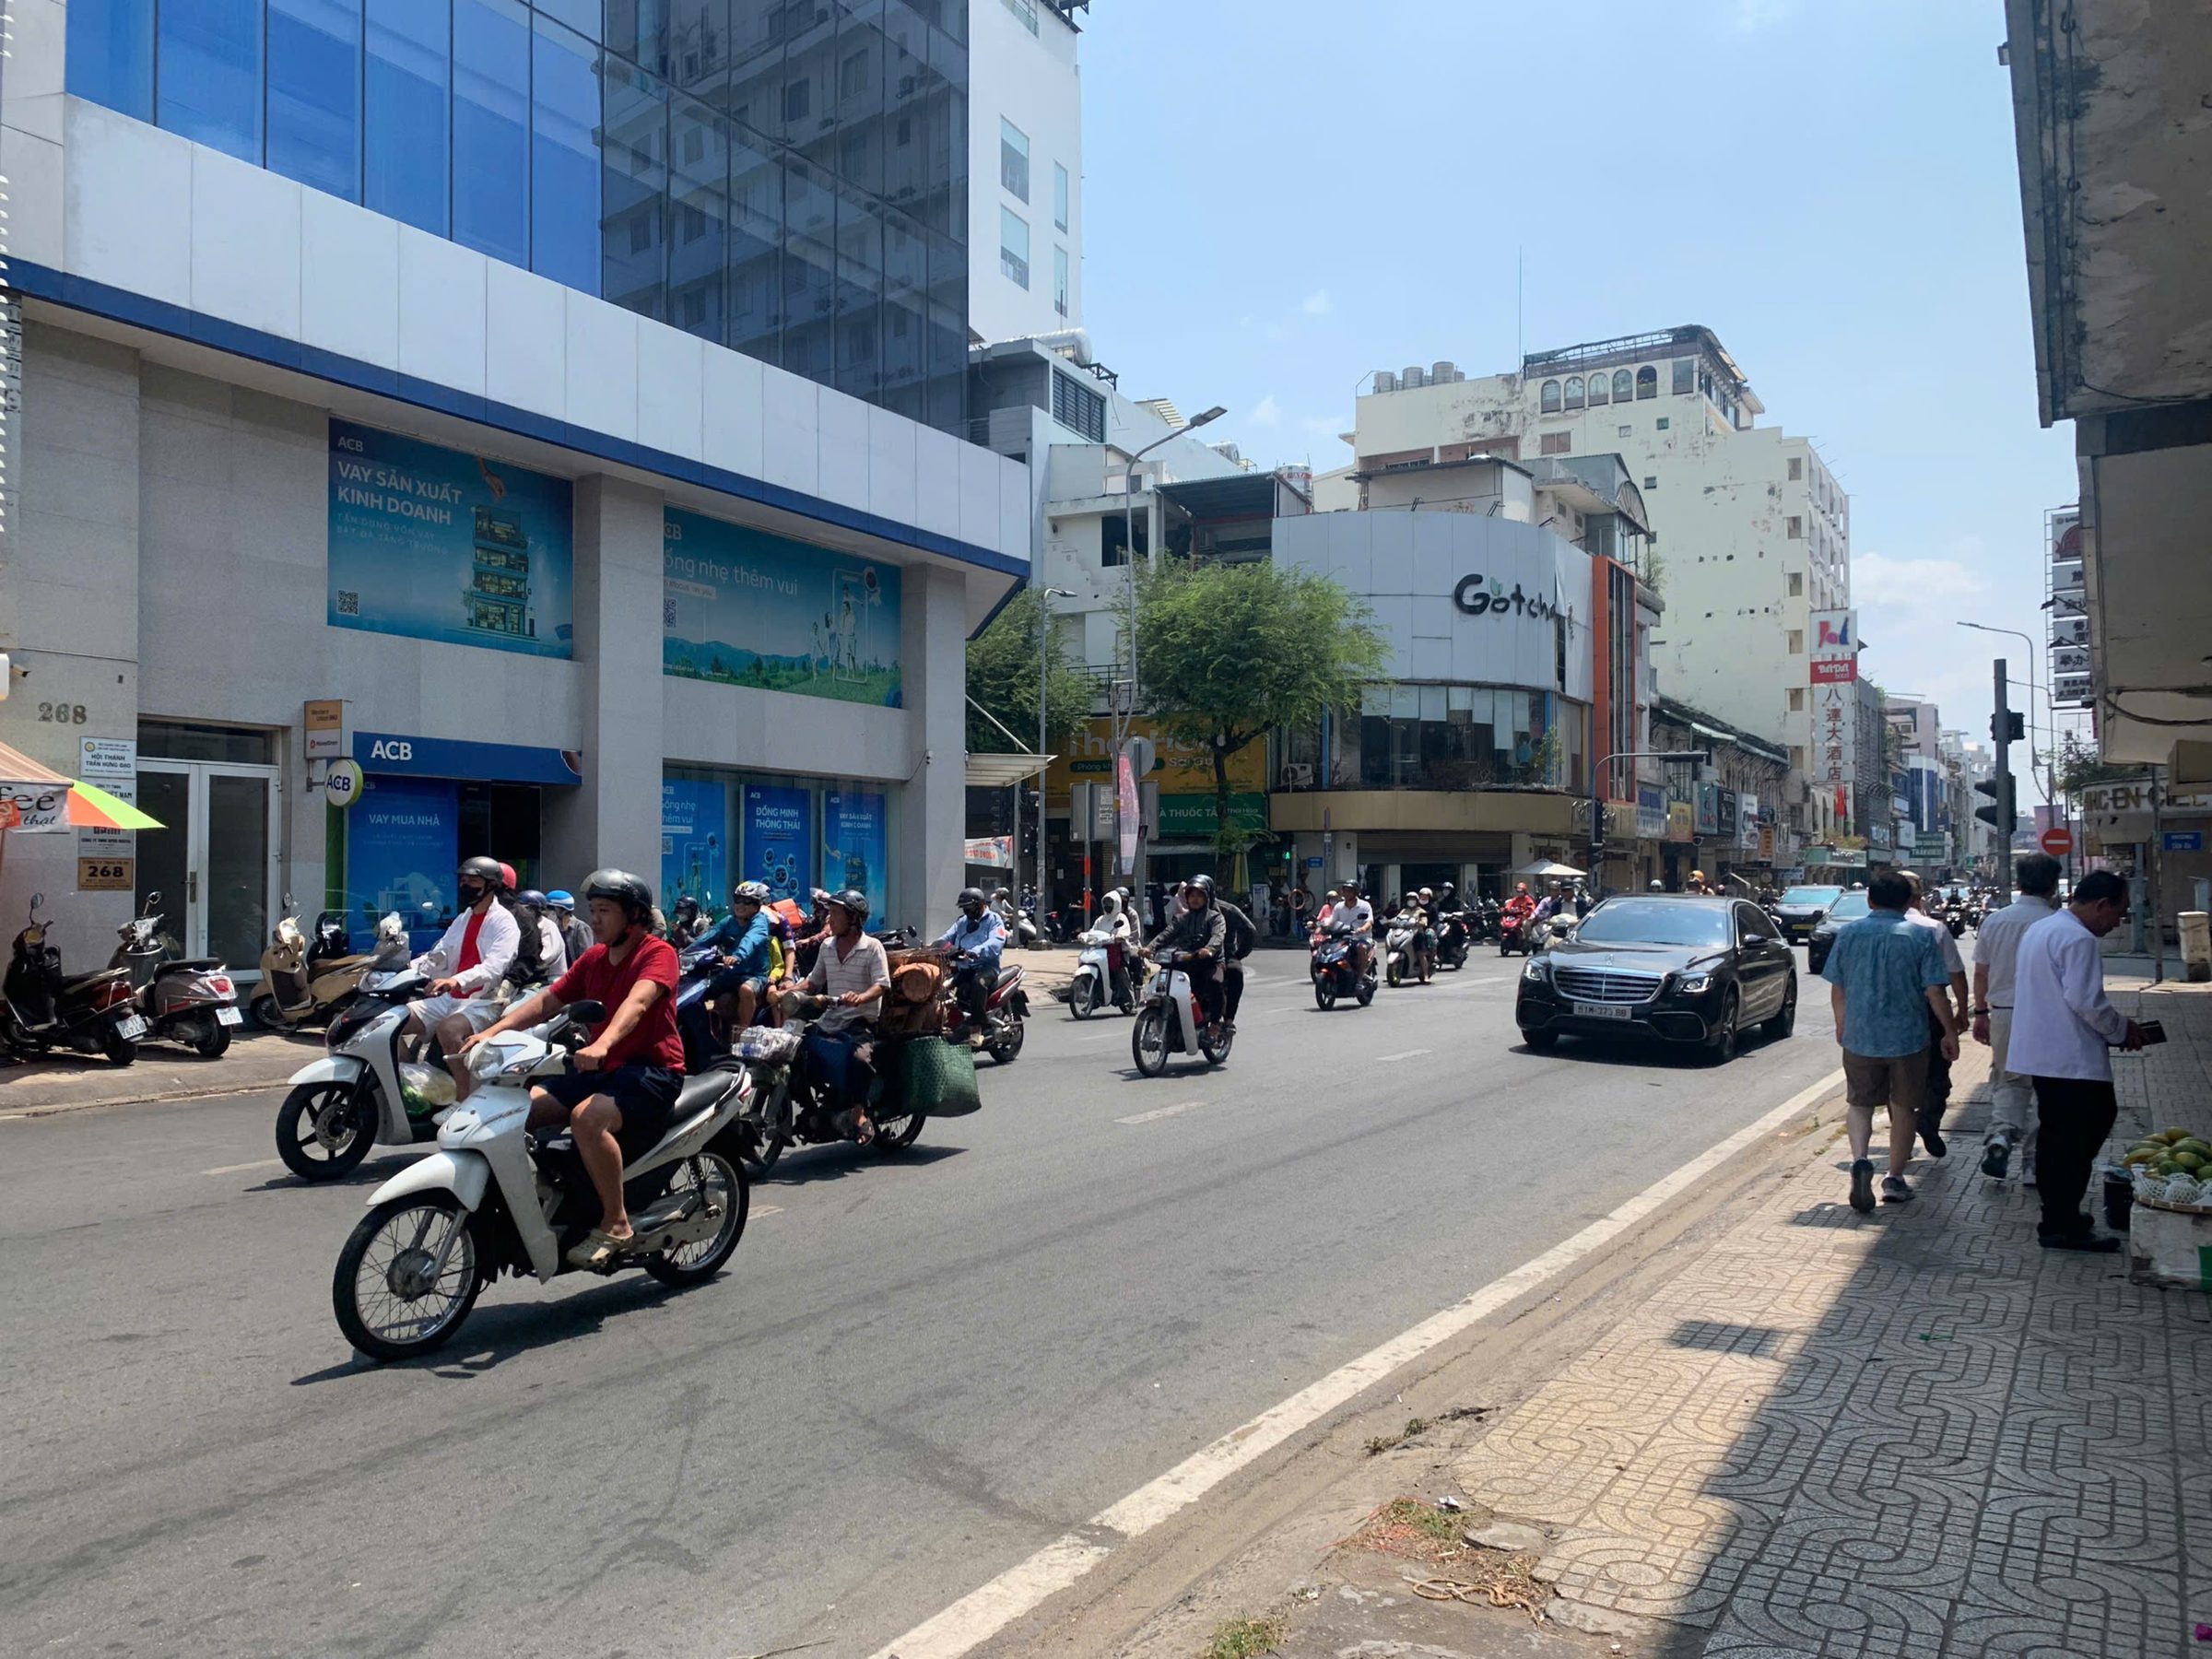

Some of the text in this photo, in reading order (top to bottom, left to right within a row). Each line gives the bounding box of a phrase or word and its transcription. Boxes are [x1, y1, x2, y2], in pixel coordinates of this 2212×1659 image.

[338, 437, 363, 452] ACB
[338, 462, 462, 504] VAY SẢN XUẤT
[338, 486, 451, 524] KINH DOANH
[664, 522, 682, 540] CB
[664, 547, 694, 578] ống
[699, 559, 728, 583] nhẹ
[733, 565, 774, 590] thêm
[777, 579, 798, 595] vui
[38, 701, 87, 724] 268
[371, 740, 412, 760] ACB
[326, 773, 351, 792] ACB
[370, 813, 441, 827] VAY MUA NHÀ
[662, 813, 680, 824] hêm
[780, 808, 799, 818] MINH
[1170, 806, 1204, 818] THUỐC
[1206, 806, 1218, 818] TÂ
[88, 865, 124, 877] 268
